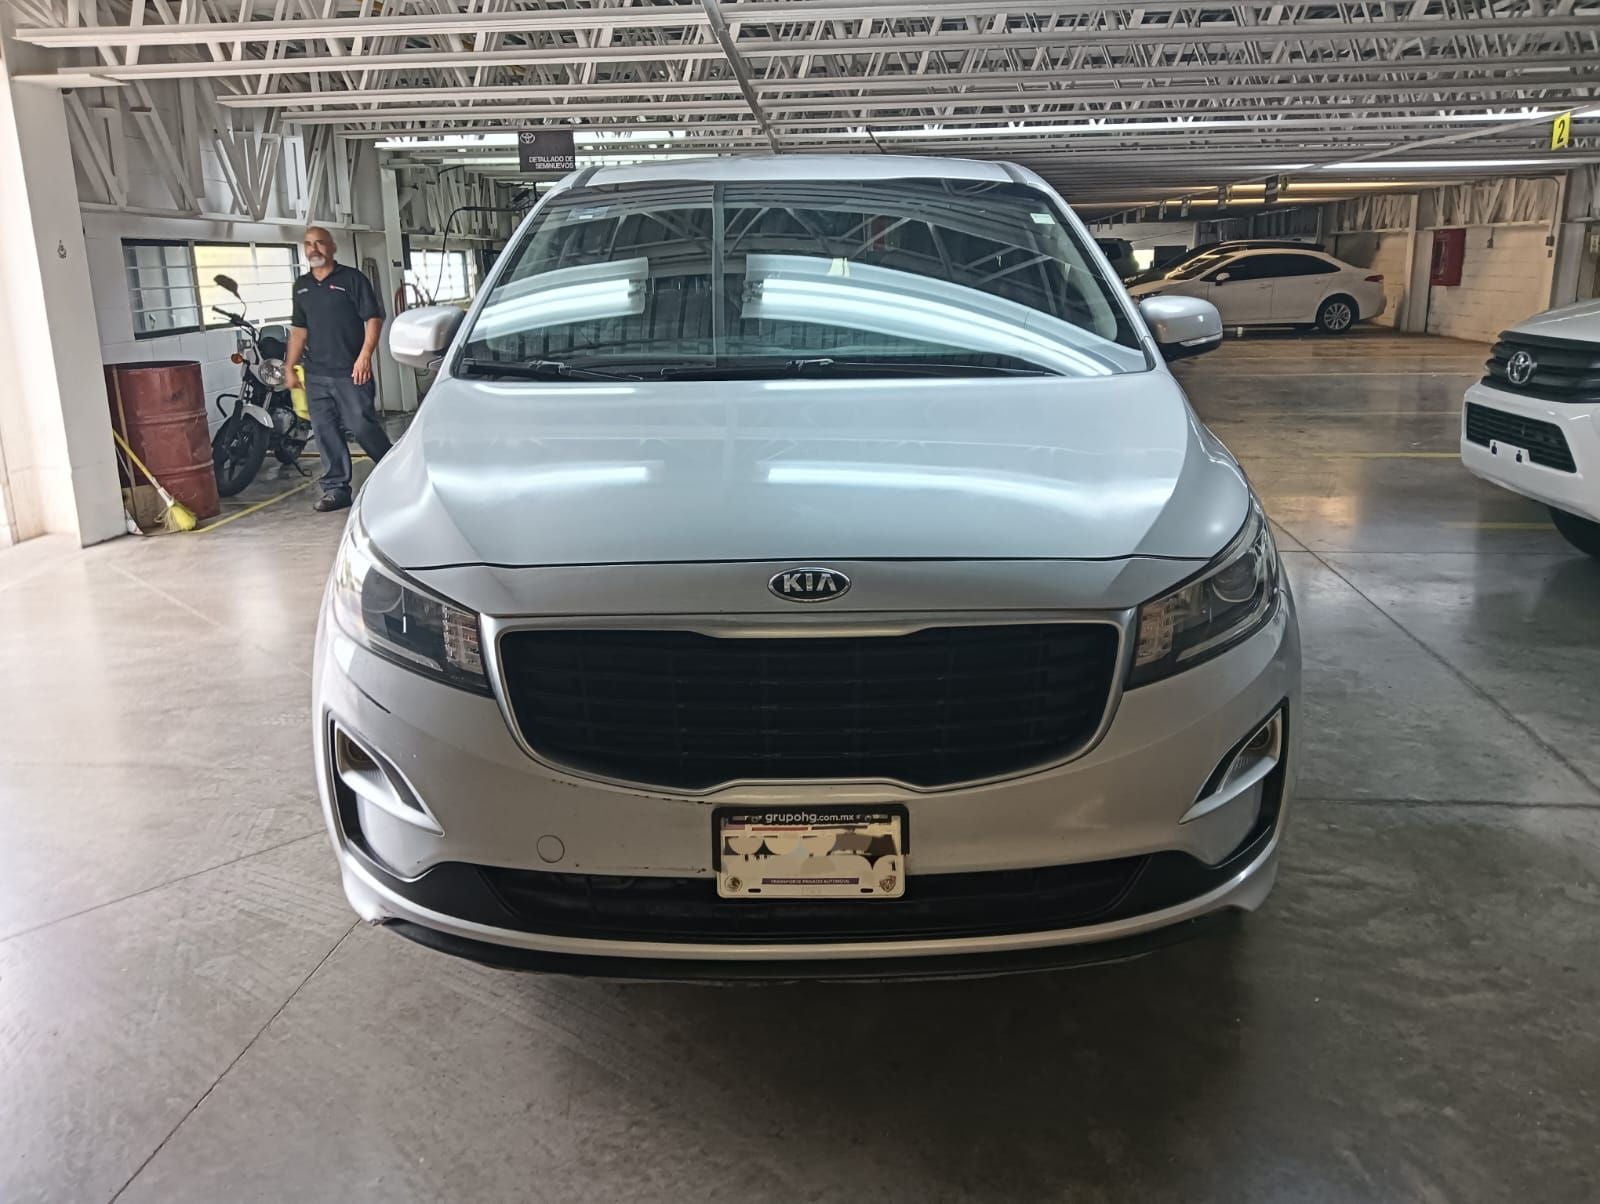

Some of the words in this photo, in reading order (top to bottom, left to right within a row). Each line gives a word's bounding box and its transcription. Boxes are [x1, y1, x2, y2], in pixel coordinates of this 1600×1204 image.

[1556, 119, 1566, 145] 2
[528, 155, 563, 163] DETALLADO
[535, 162, 574, 170] SEMINUEVOS
[782, 573, 838, 592] KIA
[765, 812, 854, 823] grupohg.com.mx
